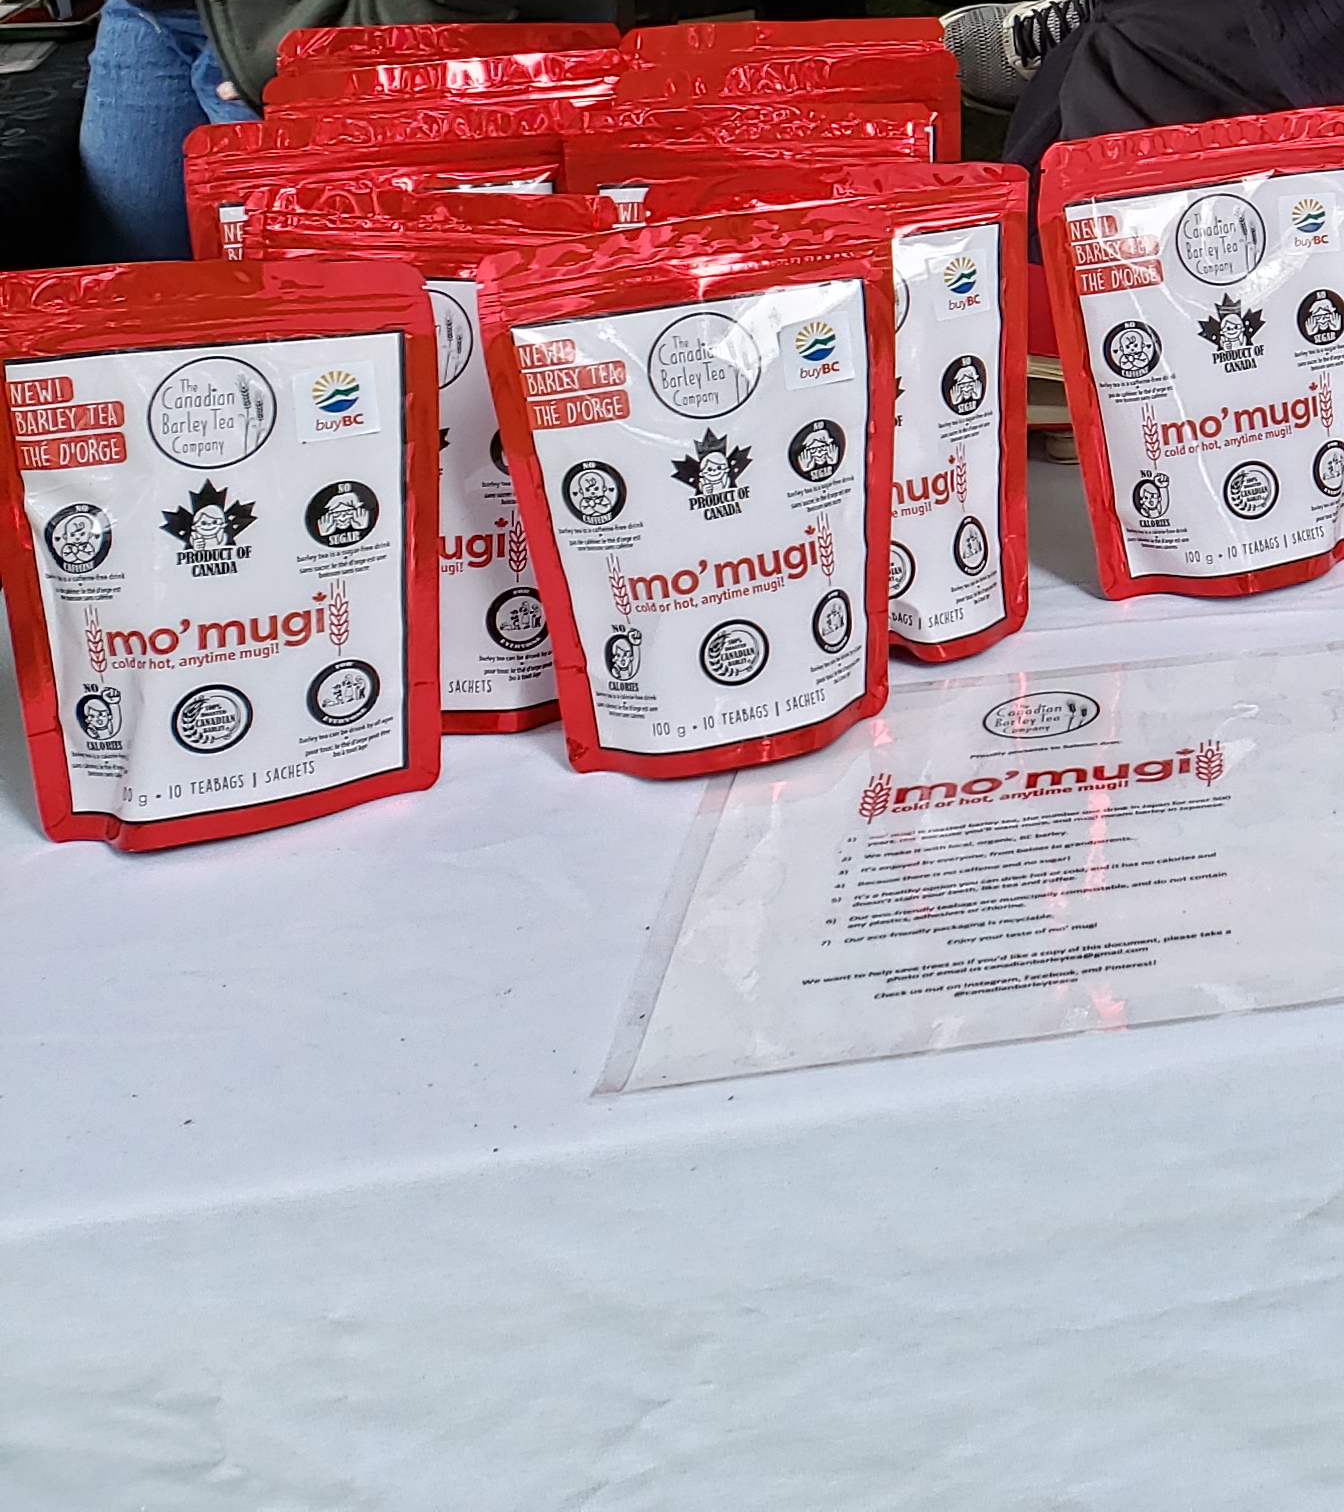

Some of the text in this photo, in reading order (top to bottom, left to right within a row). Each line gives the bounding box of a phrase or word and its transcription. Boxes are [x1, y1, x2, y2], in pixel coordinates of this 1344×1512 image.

[1294, 234, 1329, 249] buyBC
[1080, 268, 1105, 291] THÉ
[948, 294, 981, 311] buyBC
[526, 367, 580, 395] BARLEY
[799, 360, 840, 380] buyBC
[10, 380, 65, 406] NEW!
[161, 383, 235, 410] Canadian
[15, 403, 118, 435] BARLEY TEA
[161, 408, 235, 437] Barley Tea
[315, 412, 365, 432] buyBC
[534, 395, 624, 426] THÉ D'ORGE
[1160, 381, 1319, 446] mo'mugi
[21, 438, 122, 468] THÉ D'ORGE
[172, 436, 225, 457] Company
[337, 483, 352, 493] NO
[688, 486, 751, 511] PRODUCT OF
[704, 502, 742, 521] CANADA
[328, 531, 361, 546] SUGAR
[1242, 525, 1325, 555] TEABAGS SACHETS
[176, 545, 252, 566] PRODUCT OF
[628, 524, 818, 601] mo'mugi
[192, 563, 239, 578] CANADA
[635, 577, 785, 614] cold or hot, anytime mugi!
[105, 591, 326, 658] mo'mugi
[928, 607, 964, 628] SACHETS
[111, 657, 136, 670] cold
[148, 657, 175, 671] hot,
[179, 650, 237, 668] anytime
[240, 642, 280, 660] mugi!
[652, 722, 671, 737] 100
[703, 716, 716, 731] 10
[721, 704, 769, 726] TEABAGS
[786, 688, 826, 712] SACHETS
[169, 760, 316, 799] 10 TEABAGS SACHETS
[893, 749, 1195, 804] mo'mugi
[890, 779, 1129, 815] cold or hot, anytime mugi!
